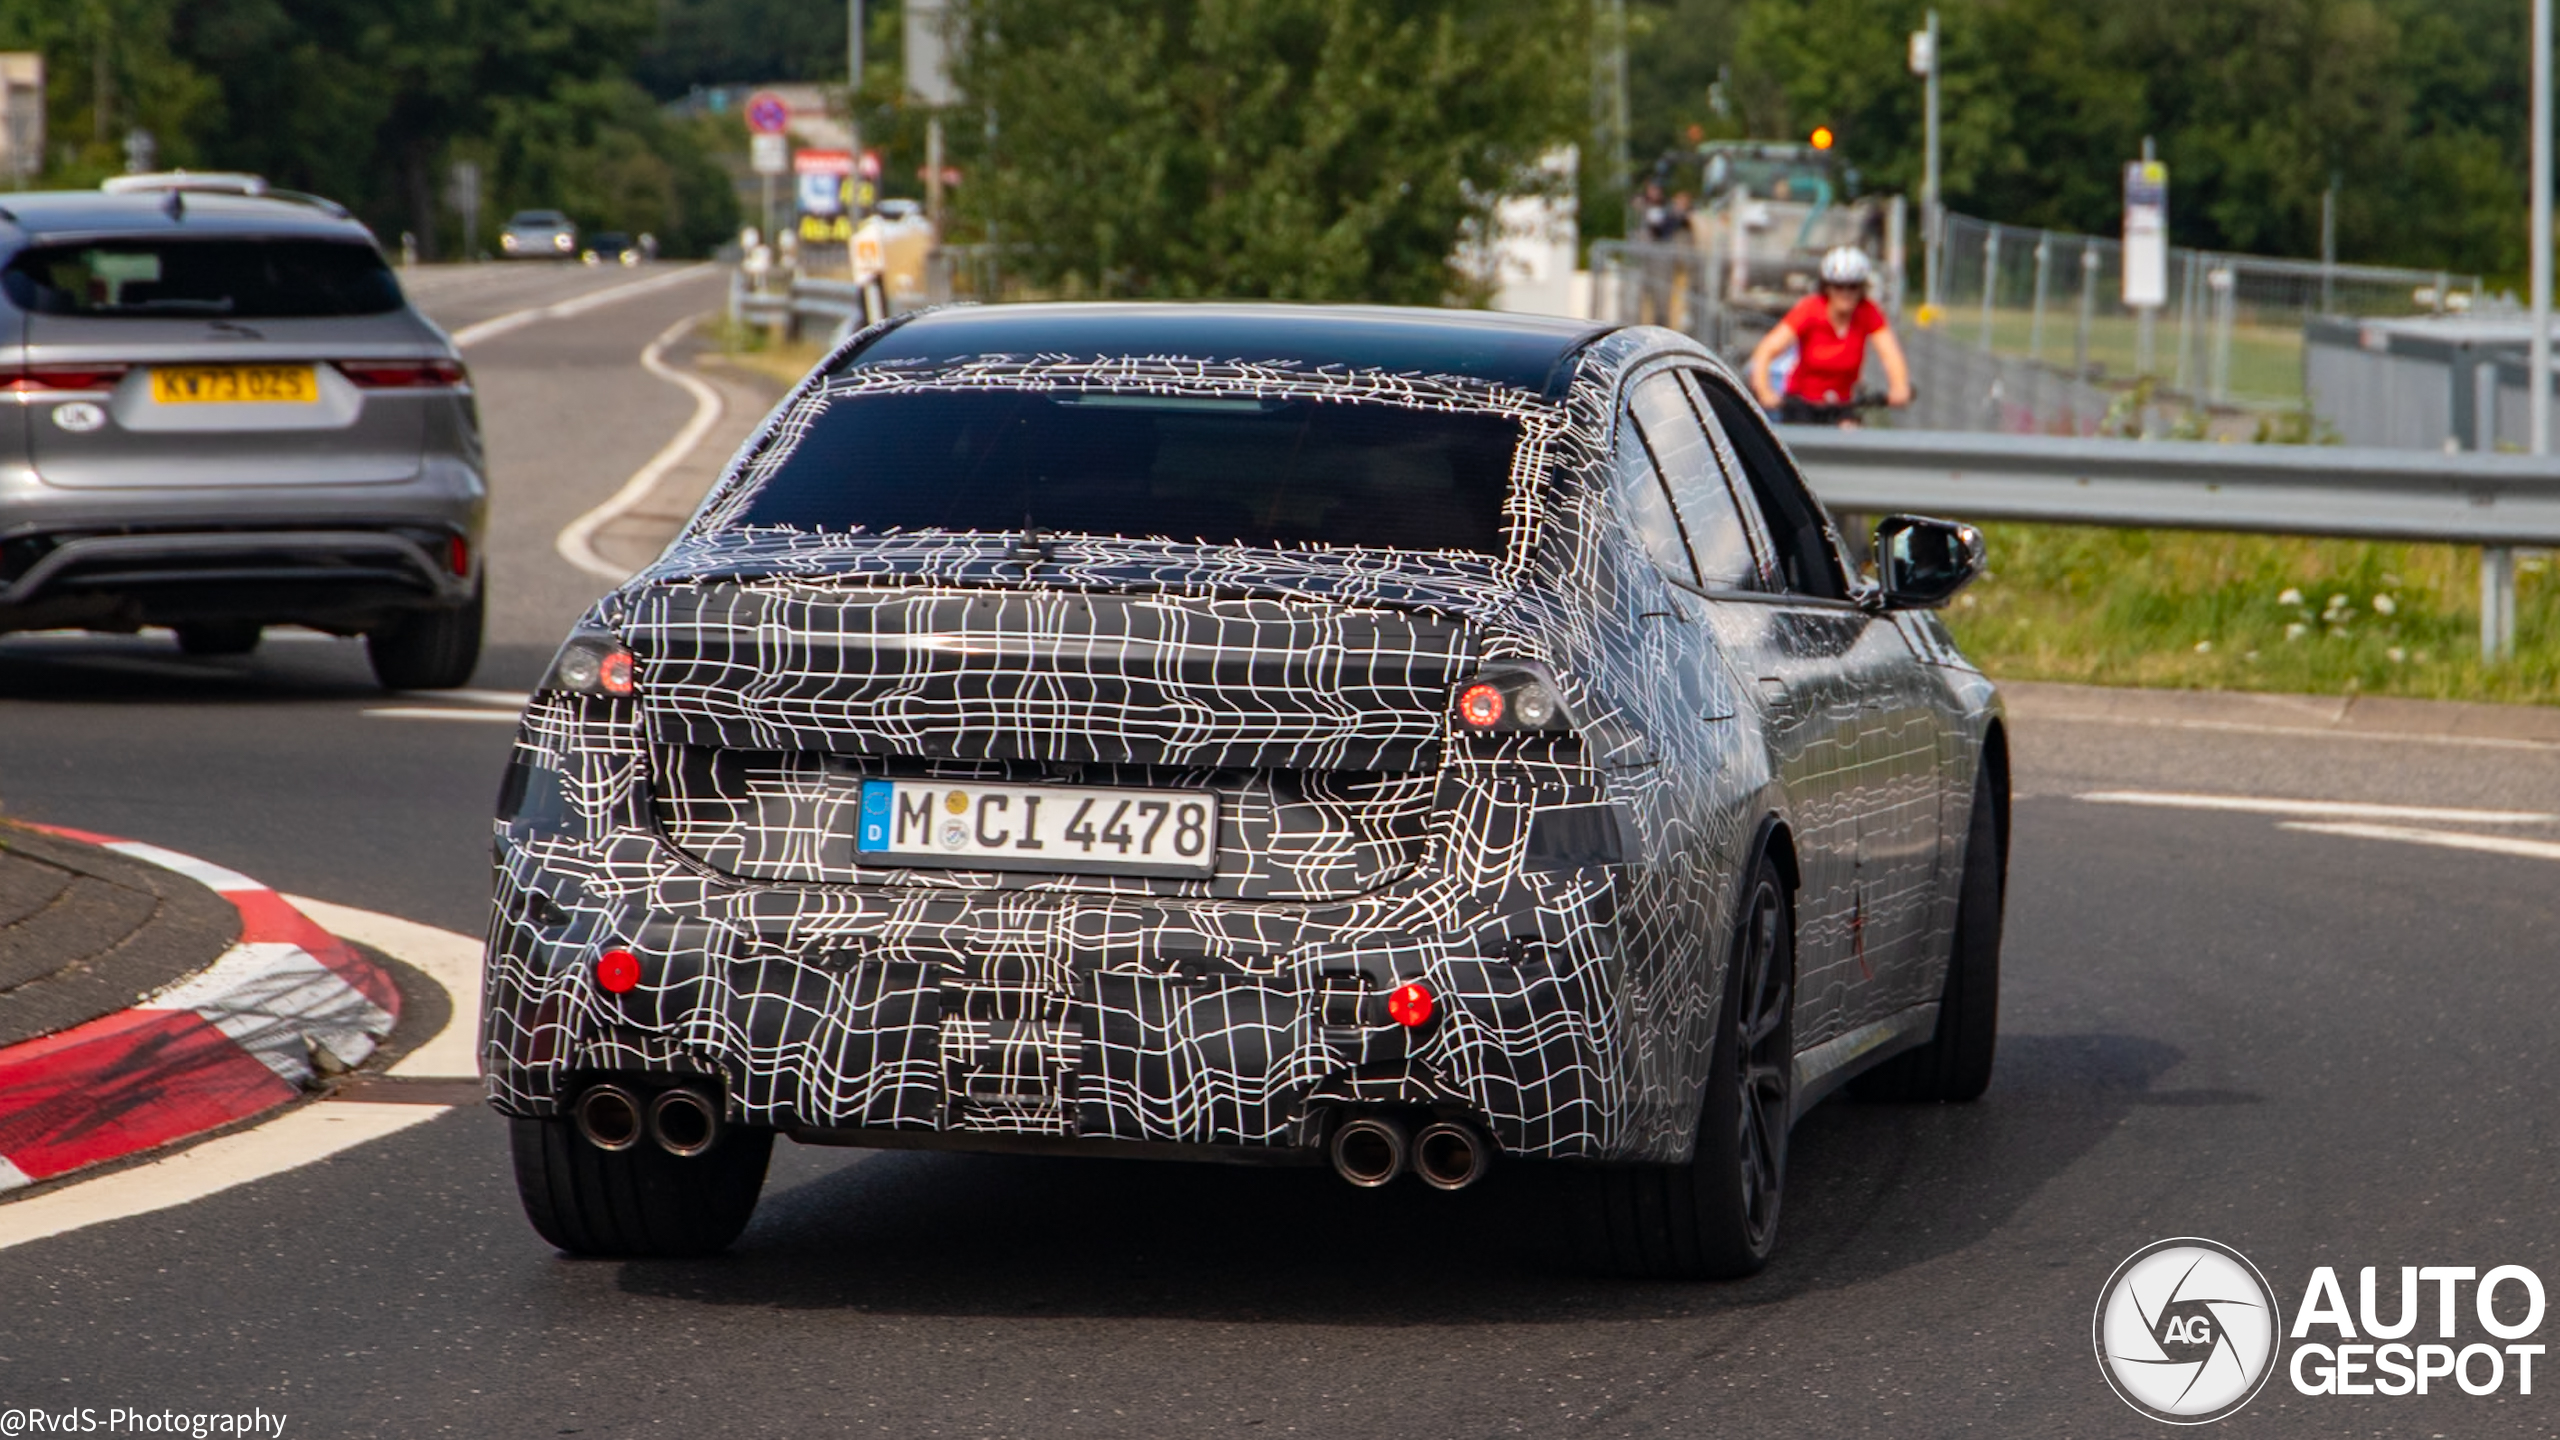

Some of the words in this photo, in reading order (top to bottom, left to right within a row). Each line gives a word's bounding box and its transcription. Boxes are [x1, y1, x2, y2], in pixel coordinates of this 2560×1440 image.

[62, 408, 91, 424] UK
[896, 791, 934, 845] M
[975, 794, 1046, 850] CI
[1065, 798, 1206, 857] 4478
[868, 825, 882, 841] D
